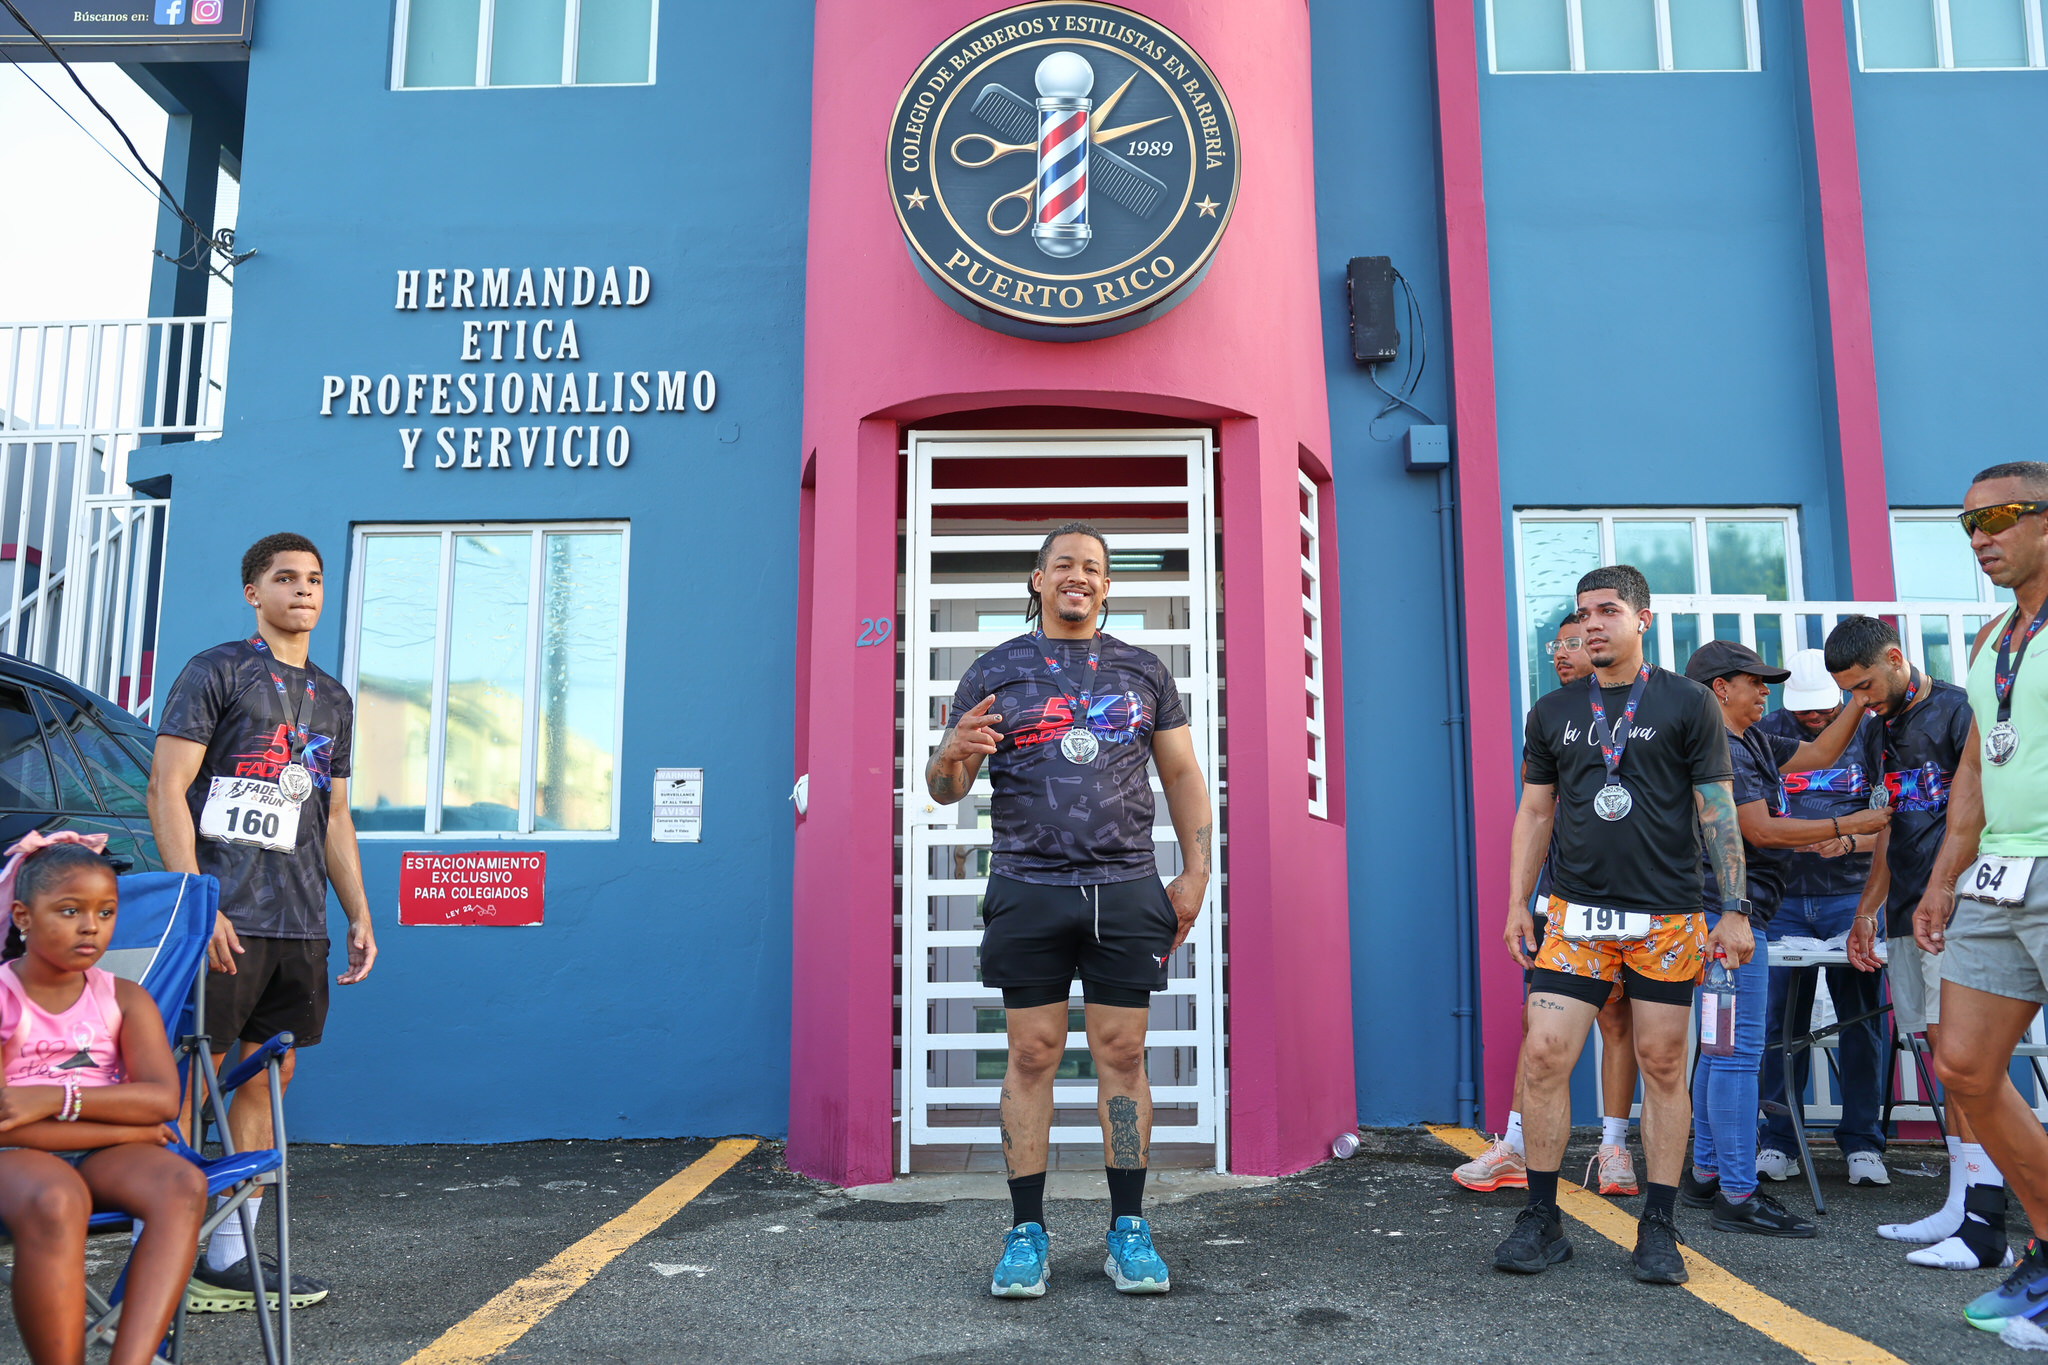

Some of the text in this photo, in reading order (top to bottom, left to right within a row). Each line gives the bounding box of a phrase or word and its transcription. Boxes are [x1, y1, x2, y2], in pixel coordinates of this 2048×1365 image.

[73, 11, 149, 22] Búscanos en:
[902, 16, 1226, 172] COLEGIO DE BARBEROS Y ESTILISTAS EN BARBERÍA
[1127, 141, 1173, 157] 1989
[395, 265, 651, 309] HERMANDAD
[945, 248, 1175, 309] PUERTO RICO
[461, 319, 580, 361] ETICA
[320, 370, 717, 415] PROFESIONALISMO
[399, 425, 630, 468] Y SERVICIO
[856, 617, 892, 647] 29
[1036, 694, 1124, 730] 5K
[244, 782, 278, 796] FADE
[1783, 768, 1848, 794] 5K
[1884, 768, 1923, 803] 5K
[259, 795, 285, 808] RUN
[660, 807, 695, 815] AVISO
[226, 806, 280, 838] 160
[406, 857, 540, 869] ESTACIONAMIENTO
[432, 871, 512, 883] EXCLUSIVO
[1976, 863, 2008, 891] 64
[414, 887, 529, 899] PARA COLEGIADOS
[445, 908, 460, 919] LEY
[1582, 908, 1626, 931] 191
